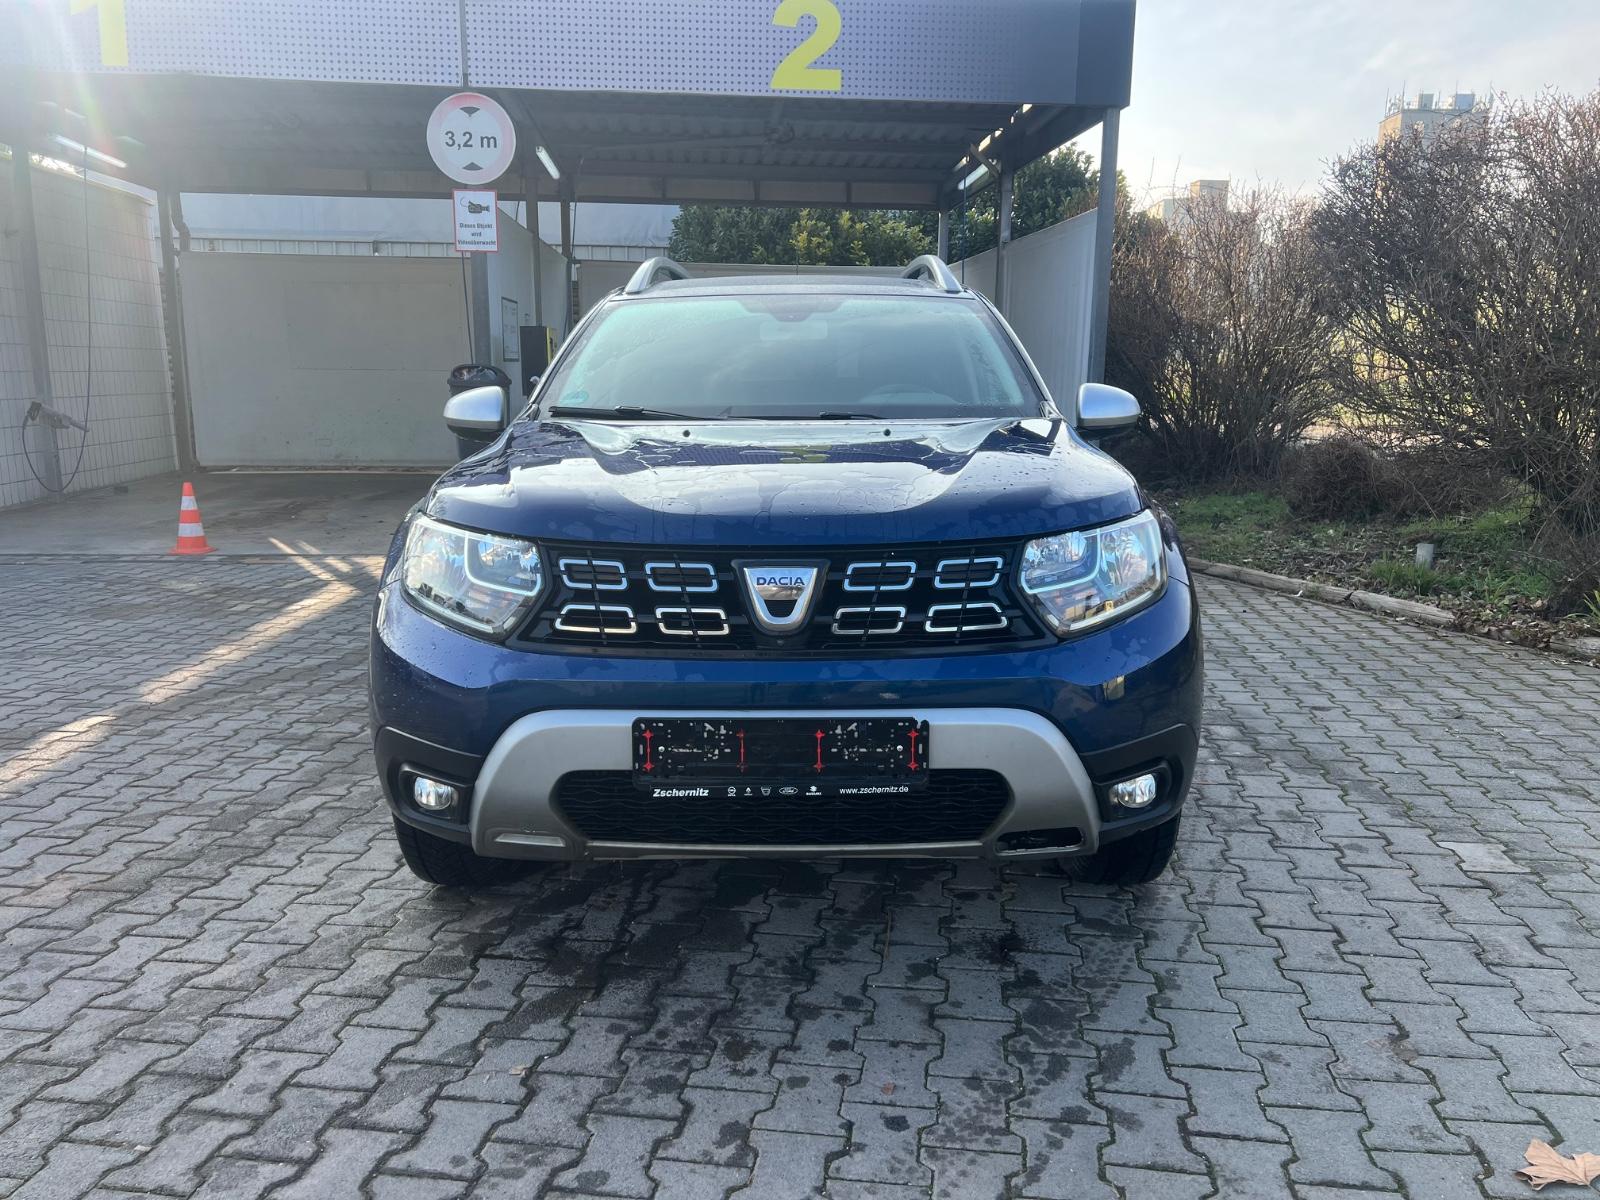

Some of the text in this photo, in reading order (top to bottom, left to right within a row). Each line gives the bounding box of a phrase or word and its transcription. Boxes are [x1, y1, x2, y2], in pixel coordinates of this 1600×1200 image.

[70, 0, 128, 67] 1
[769, 0, 842, 91] 2
[444, 130, 498, 150] 3,2 m
[756, 576, 805, 586] DACIA
[652, 787, 709, 798] Zschernitz
[839, 785, 909, 795] www.zschernitz.de
